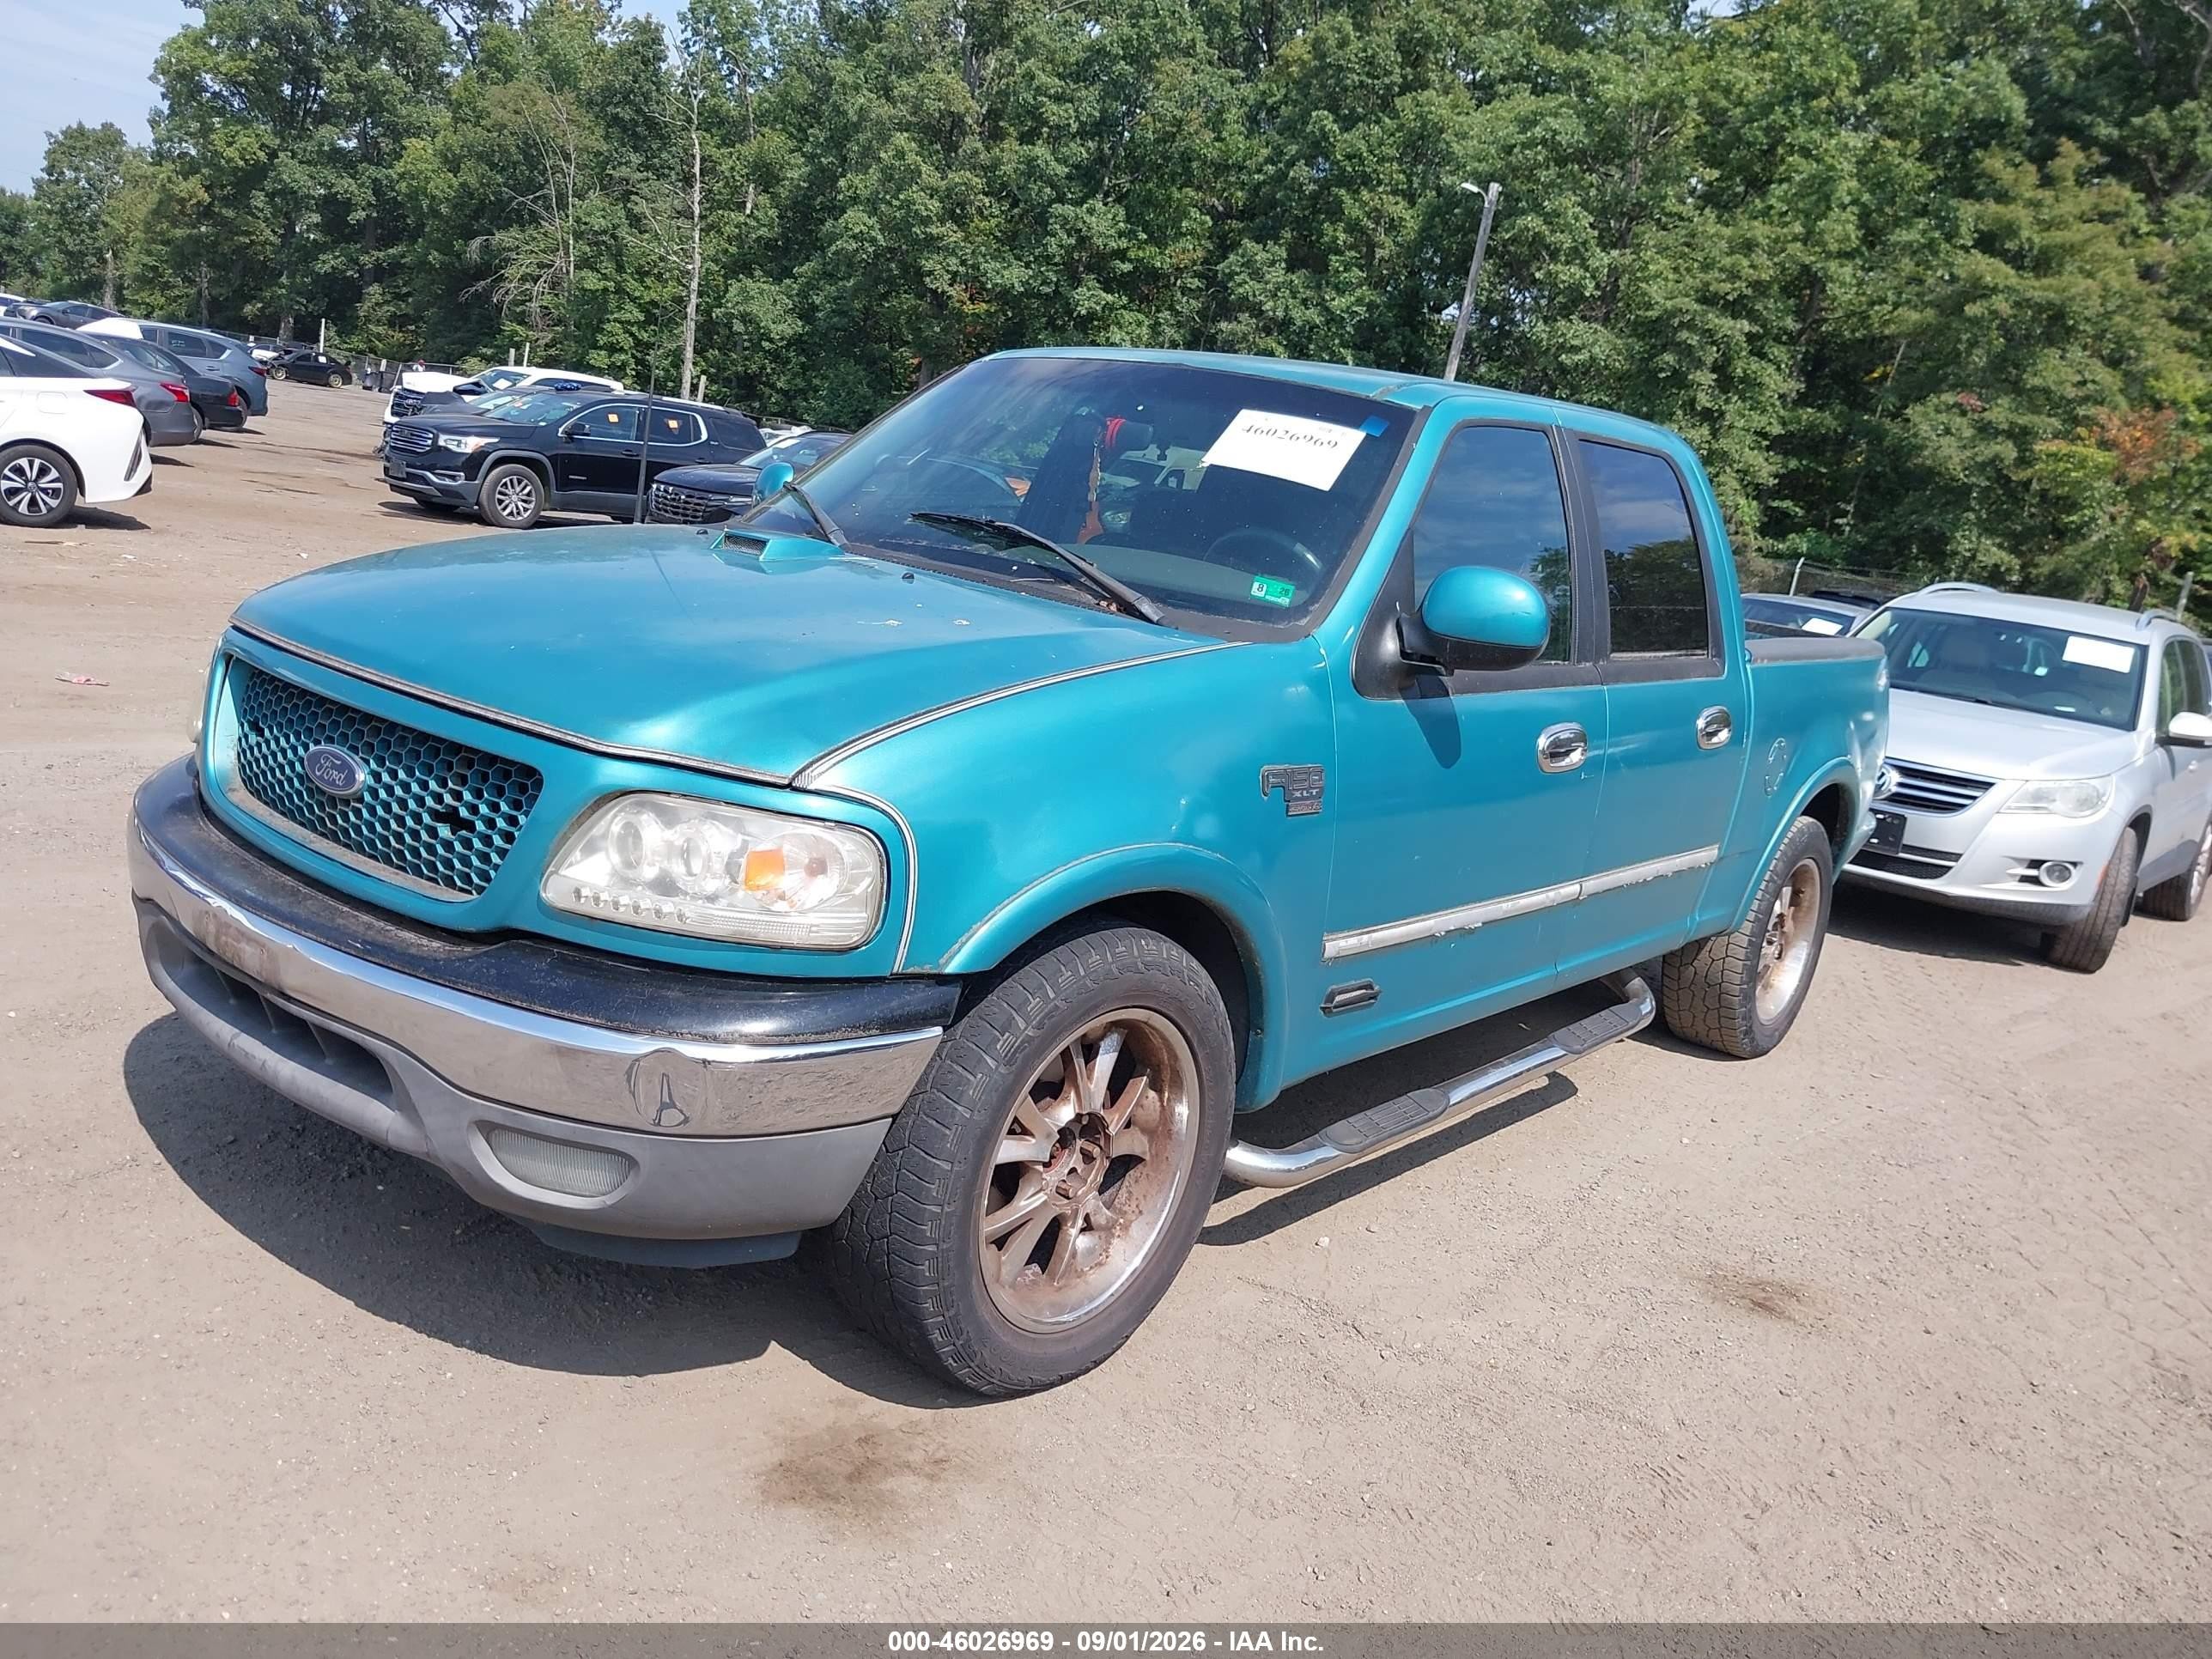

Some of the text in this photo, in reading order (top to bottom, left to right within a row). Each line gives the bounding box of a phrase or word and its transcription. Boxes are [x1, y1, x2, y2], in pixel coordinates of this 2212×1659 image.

[1242, 424, 1338, 448] 46026969
[1256, 583, 1291, 596] 8 26
[315, 754, 348, 786] Ford
[1292, 788, 1320, 798] XLT
